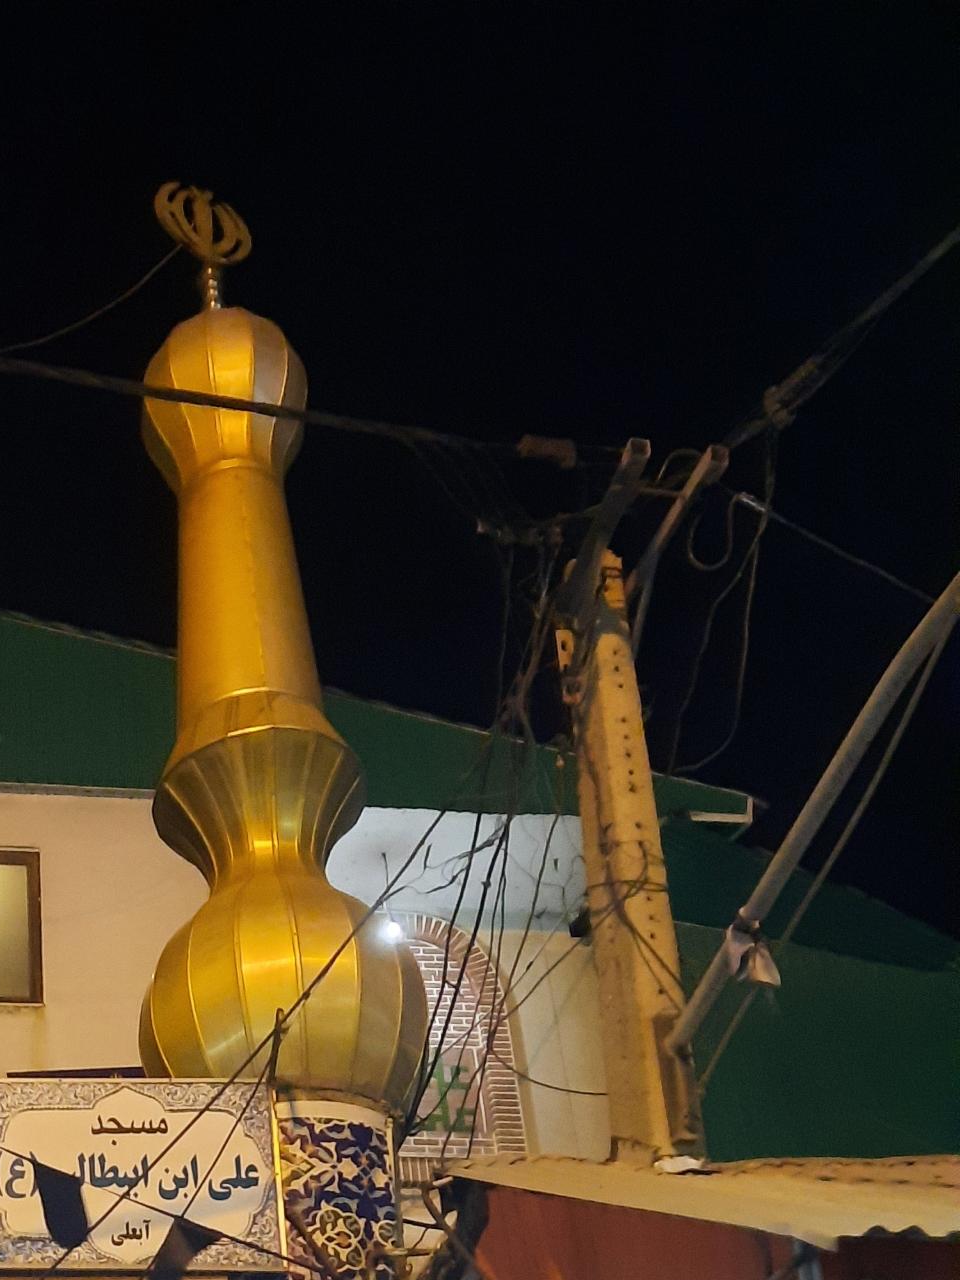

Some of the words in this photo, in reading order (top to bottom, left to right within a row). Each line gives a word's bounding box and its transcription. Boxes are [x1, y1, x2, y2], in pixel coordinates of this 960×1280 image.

[91, 1114, 169, 1146] مسجد
[74, 1152, 149, 1198] ابیطال
[158, 1156, 198, 1200] ابن
[208, 1154, 260, 1201] علی
[111, 1220, 150, 1246] آبعلی
